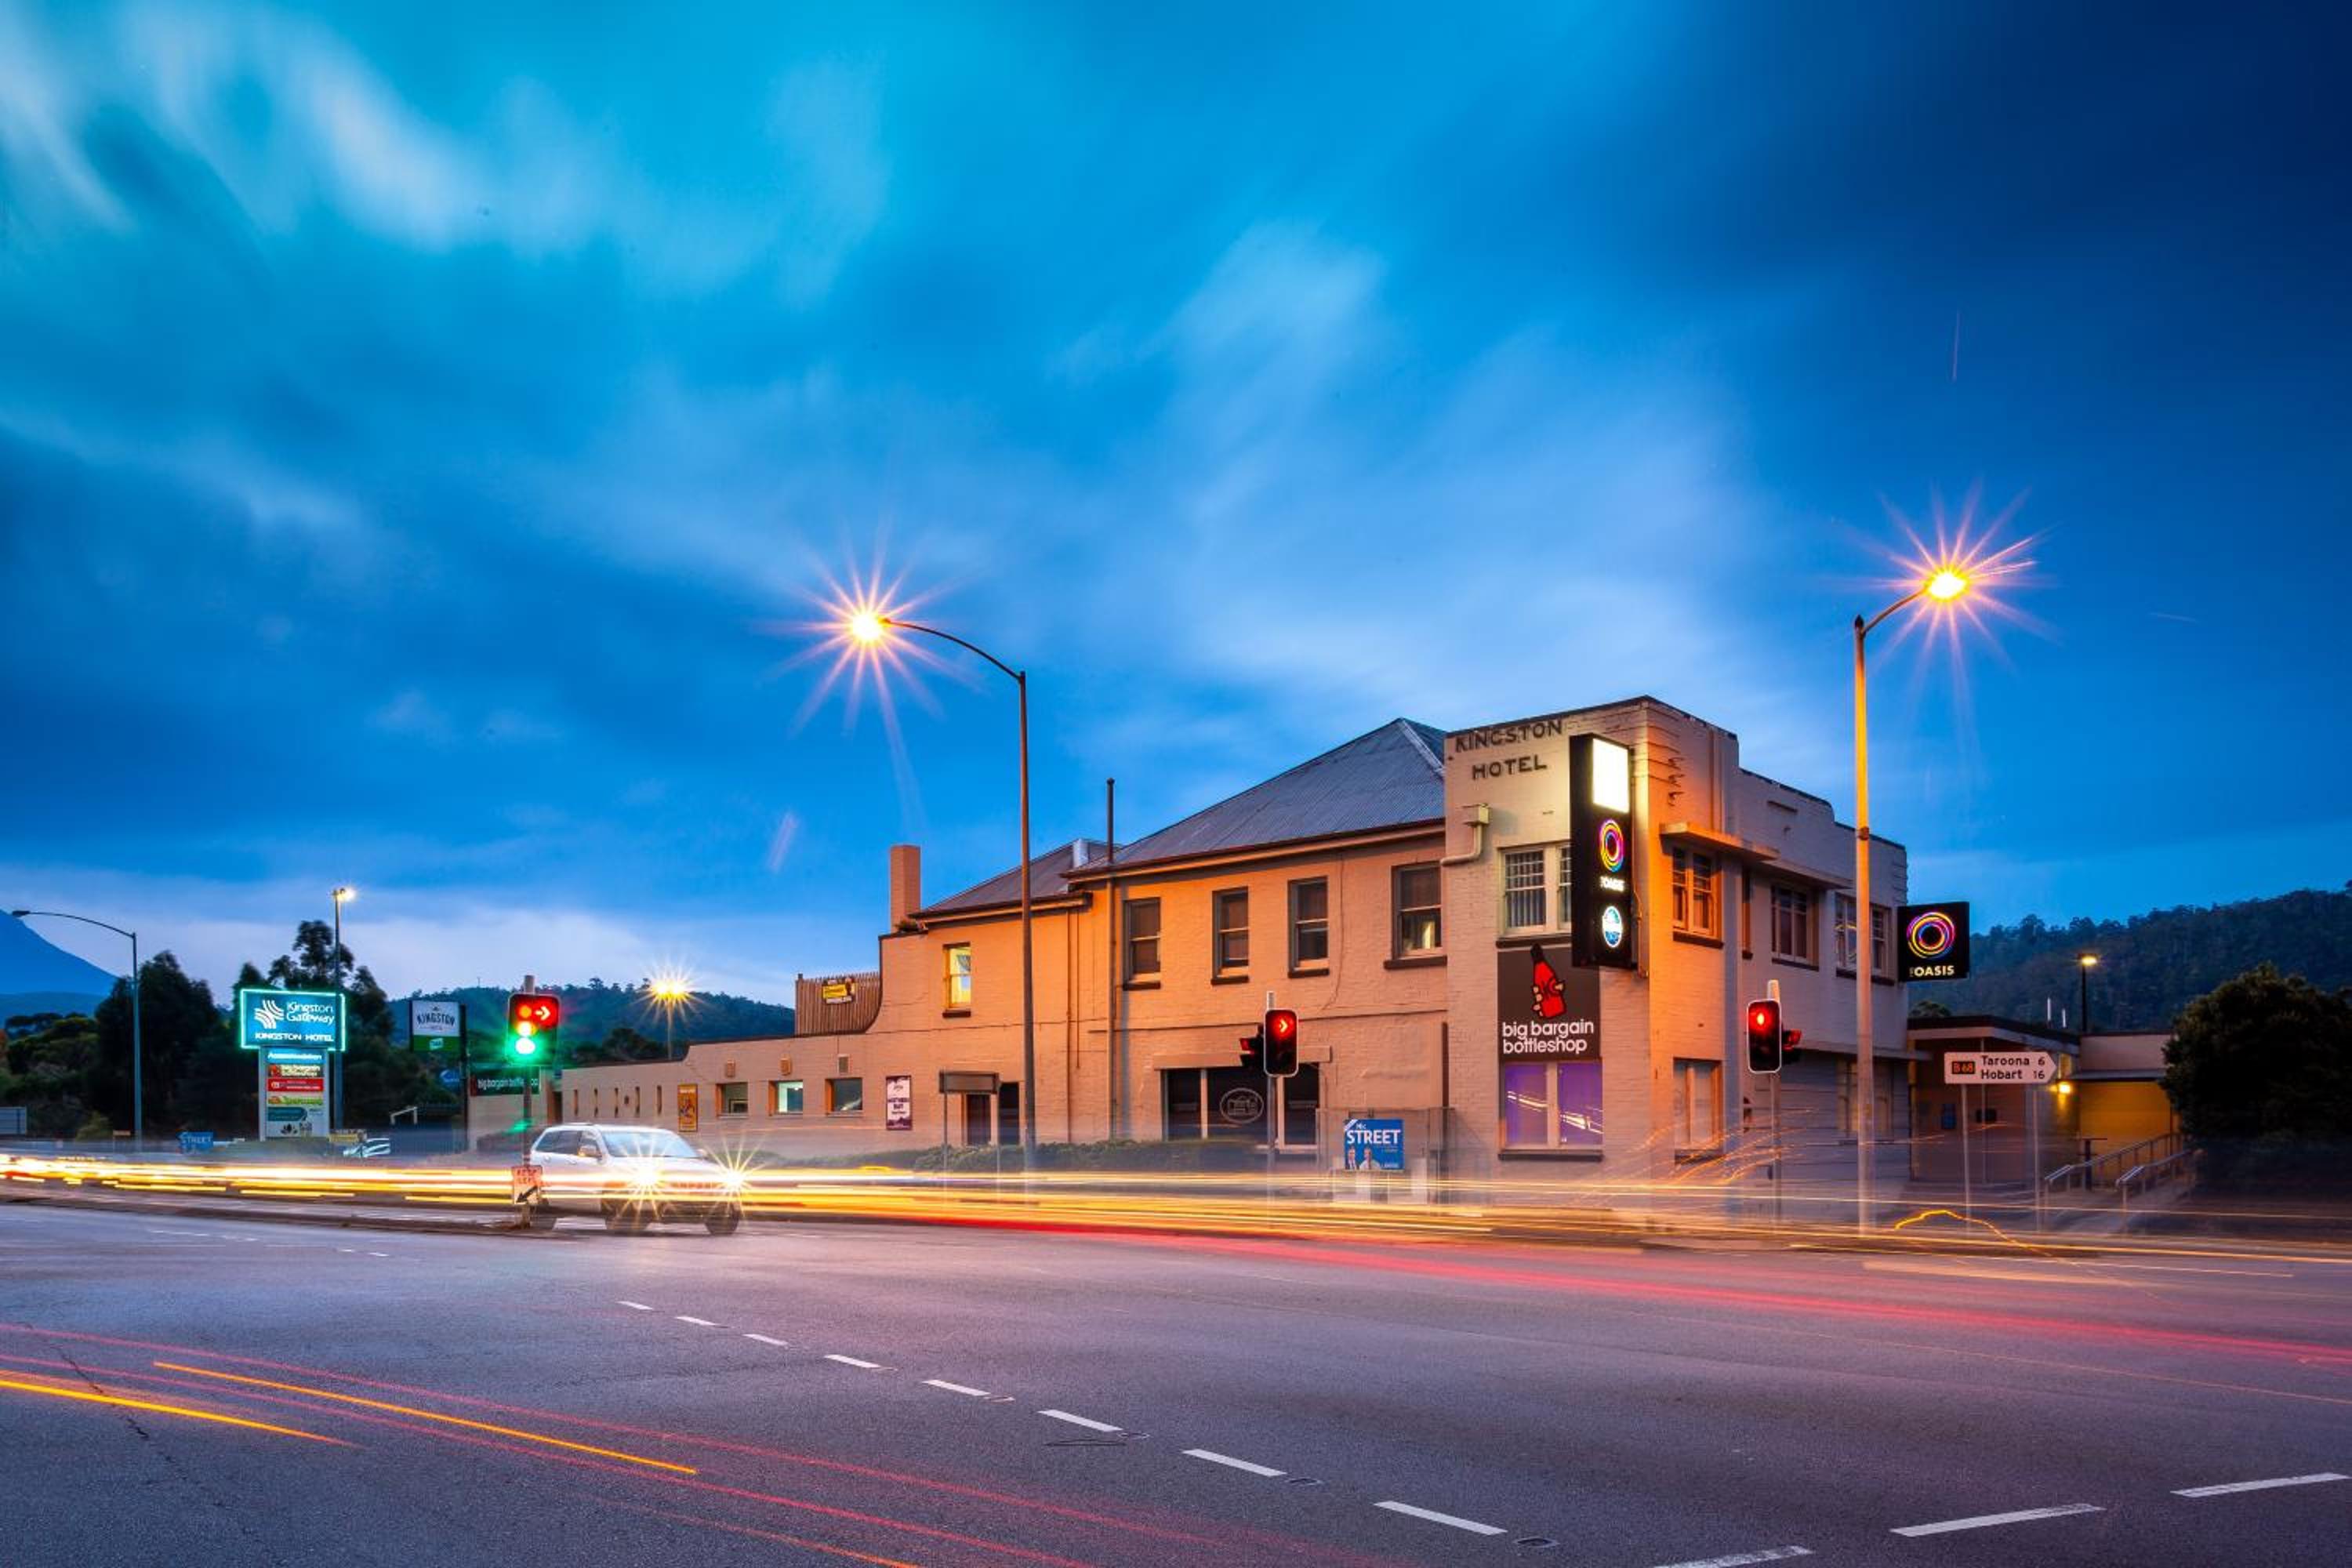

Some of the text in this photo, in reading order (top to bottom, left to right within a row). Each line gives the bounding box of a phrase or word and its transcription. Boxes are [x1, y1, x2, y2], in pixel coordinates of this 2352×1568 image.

[1455, 719, 1563, 753] KINGSTON
[1472, 753, 1548, 781] HOTEL
[286, 1002, 333, 1014] Kingston
[286, 1012, 335, 1025] Gateway
[417, 1012, 455, 1026] KINGSTON
[1502, 1019, 1594, 1040] big bargain
[305, 1033, 334, 1042] HOTEL
[1503, 1036, 1588, 1054] bottleshop
[1981, 1054, 2045, 1065] Taroona 6
[1981, 1069, 2045, 1080] Hobart 16
[1346, 1130, 1401, 1145] STREET
